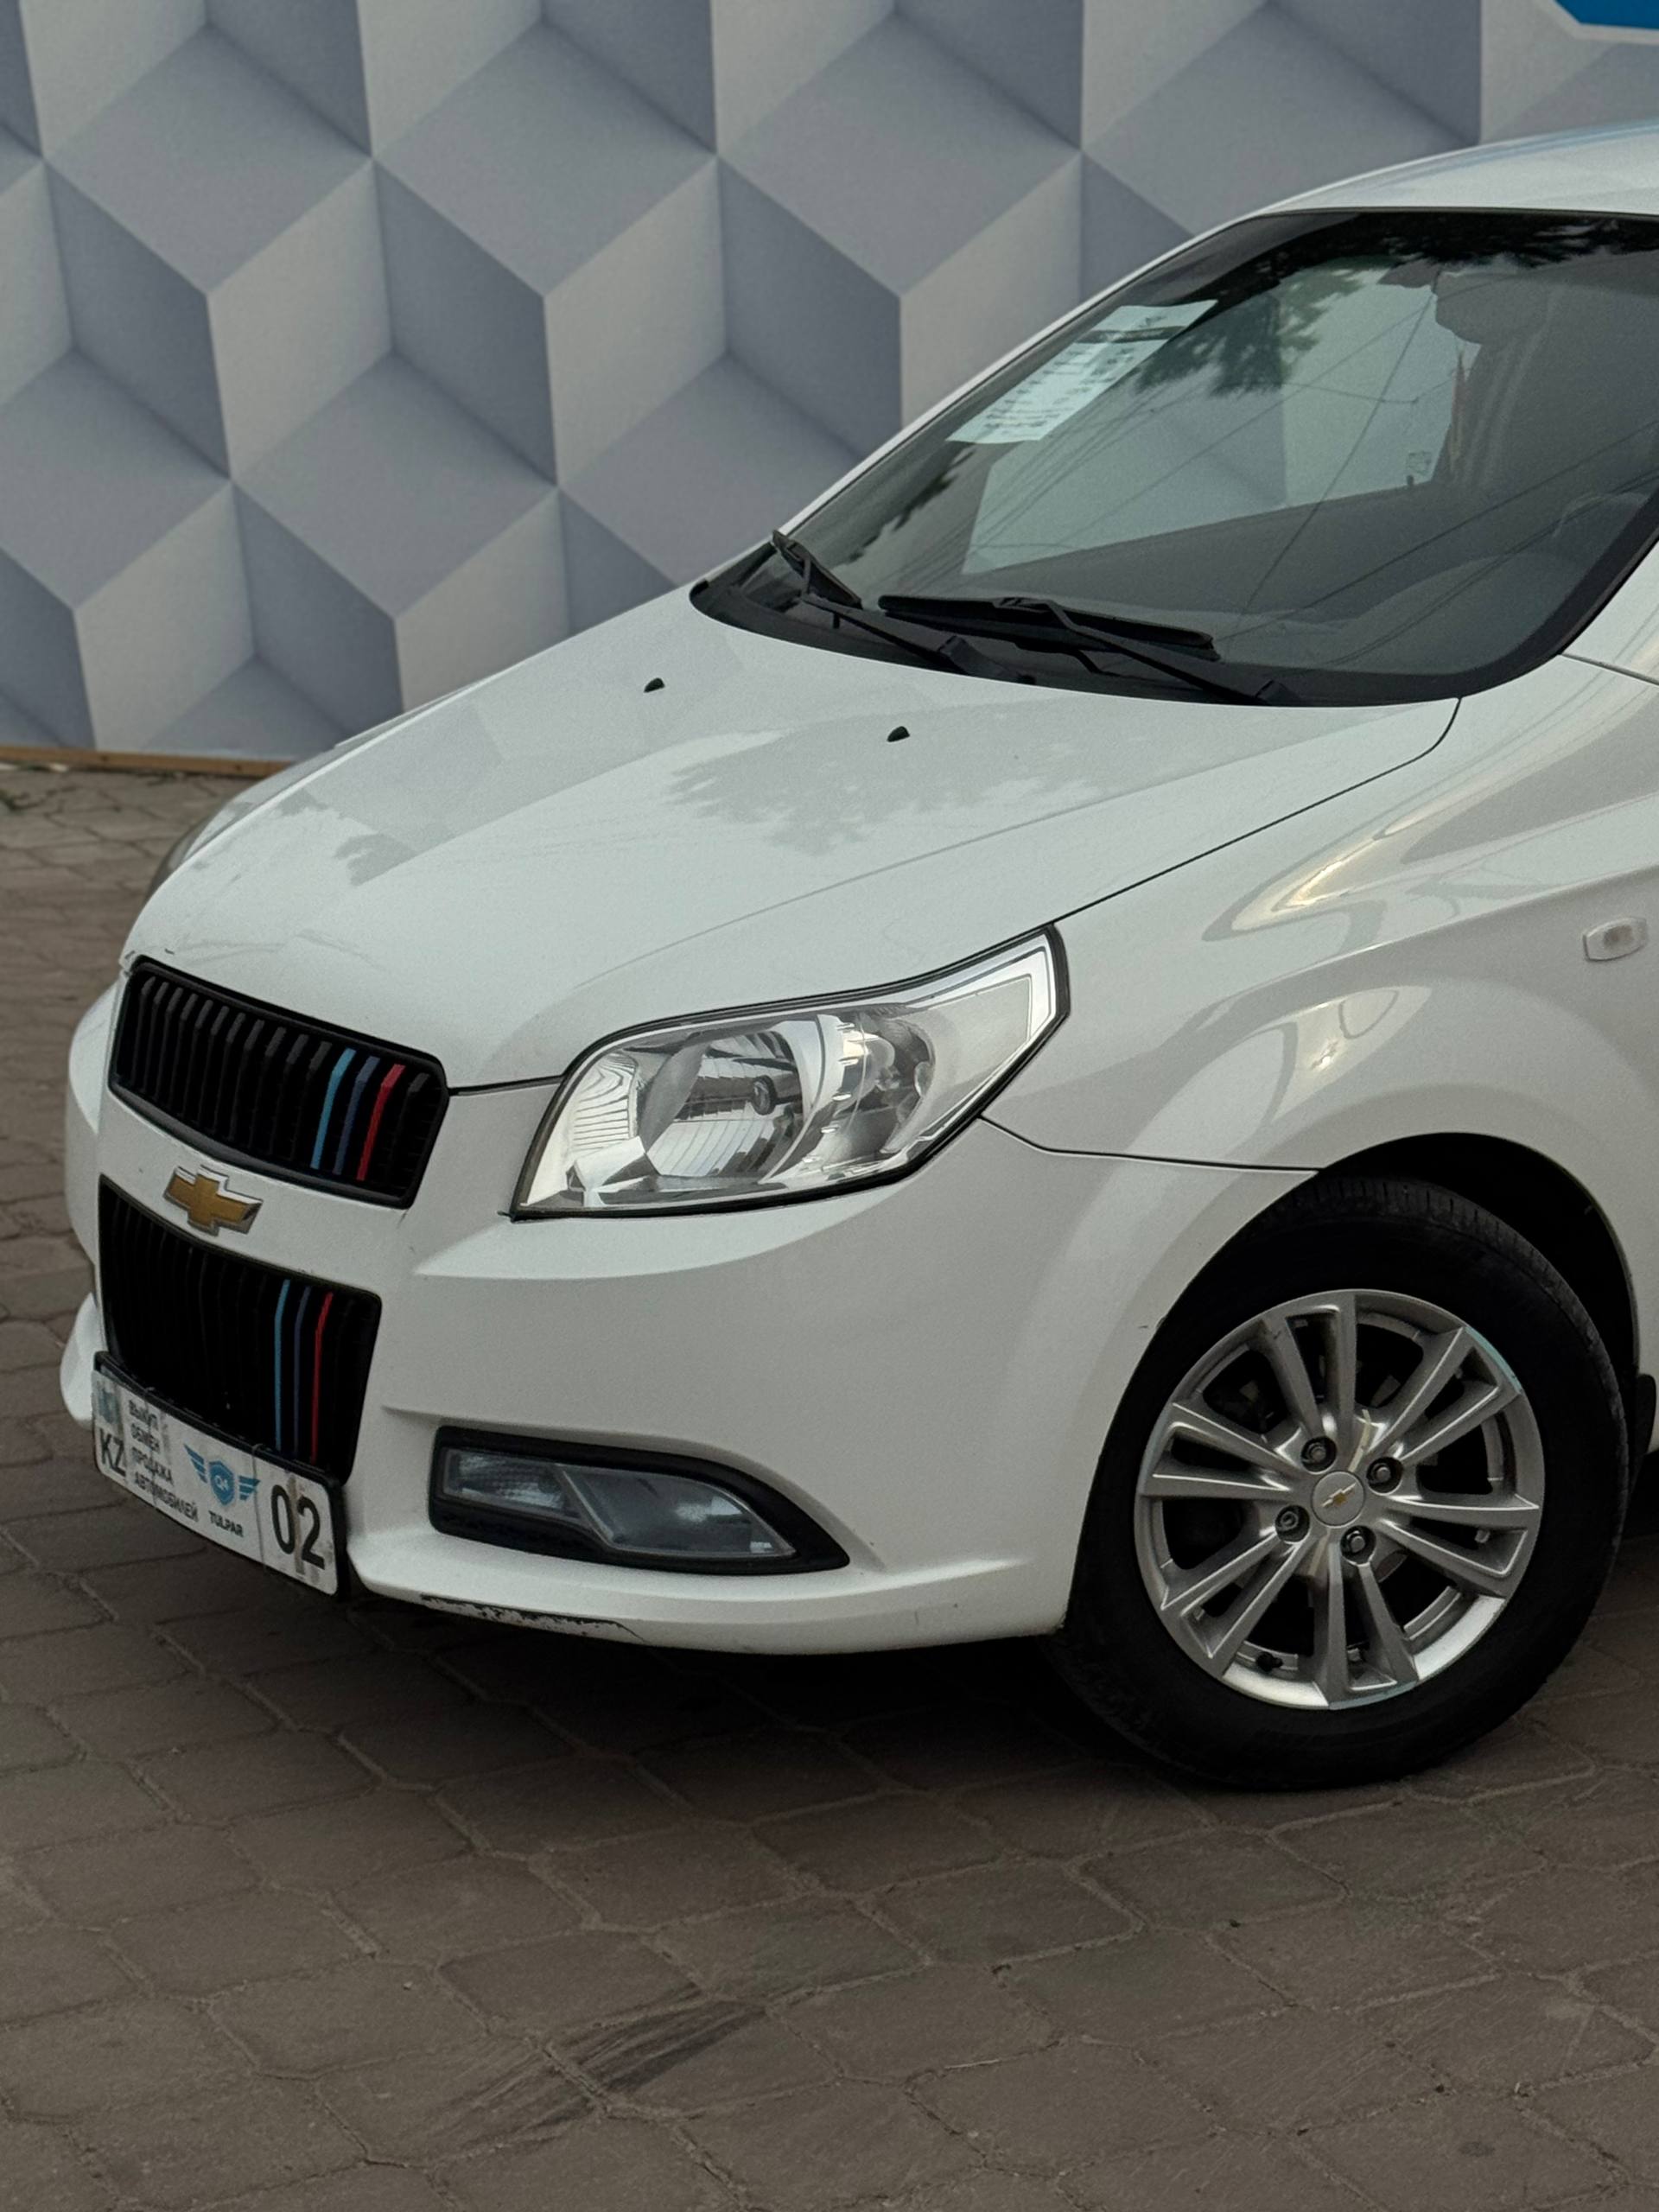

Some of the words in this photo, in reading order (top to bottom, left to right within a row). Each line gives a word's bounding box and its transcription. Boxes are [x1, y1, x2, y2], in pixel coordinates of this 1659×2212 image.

[99, 1429, 126, 1477] KZ
[132, 1447, 174, 1486] ПРОДАЖА
[208, 1510, 244, 1537] TULPAR
[270, 1484, 325, 1570] 02
